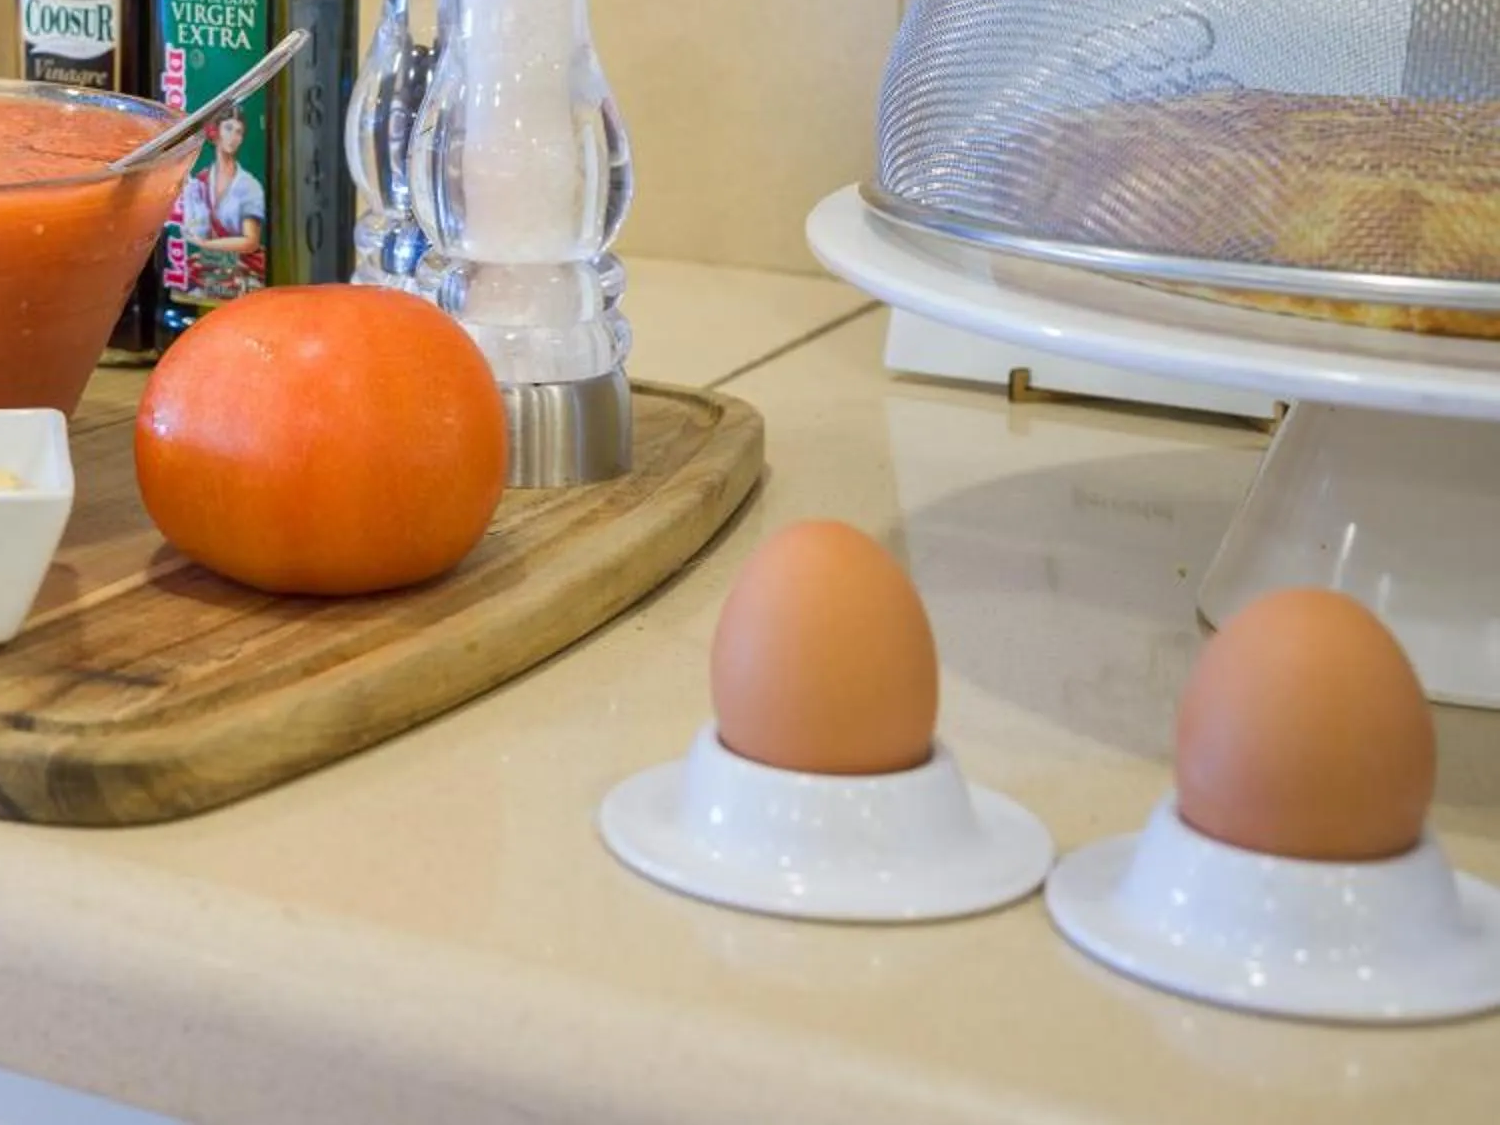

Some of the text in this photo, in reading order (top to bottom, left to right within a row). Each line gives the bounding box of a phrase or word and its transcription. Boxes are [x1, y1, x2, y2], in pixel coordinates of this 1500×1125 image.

[171, 1, 256, 29] VIRGEN
[178, 22, 252, 50] EXTRA
[163, 239, 188, 291] La
